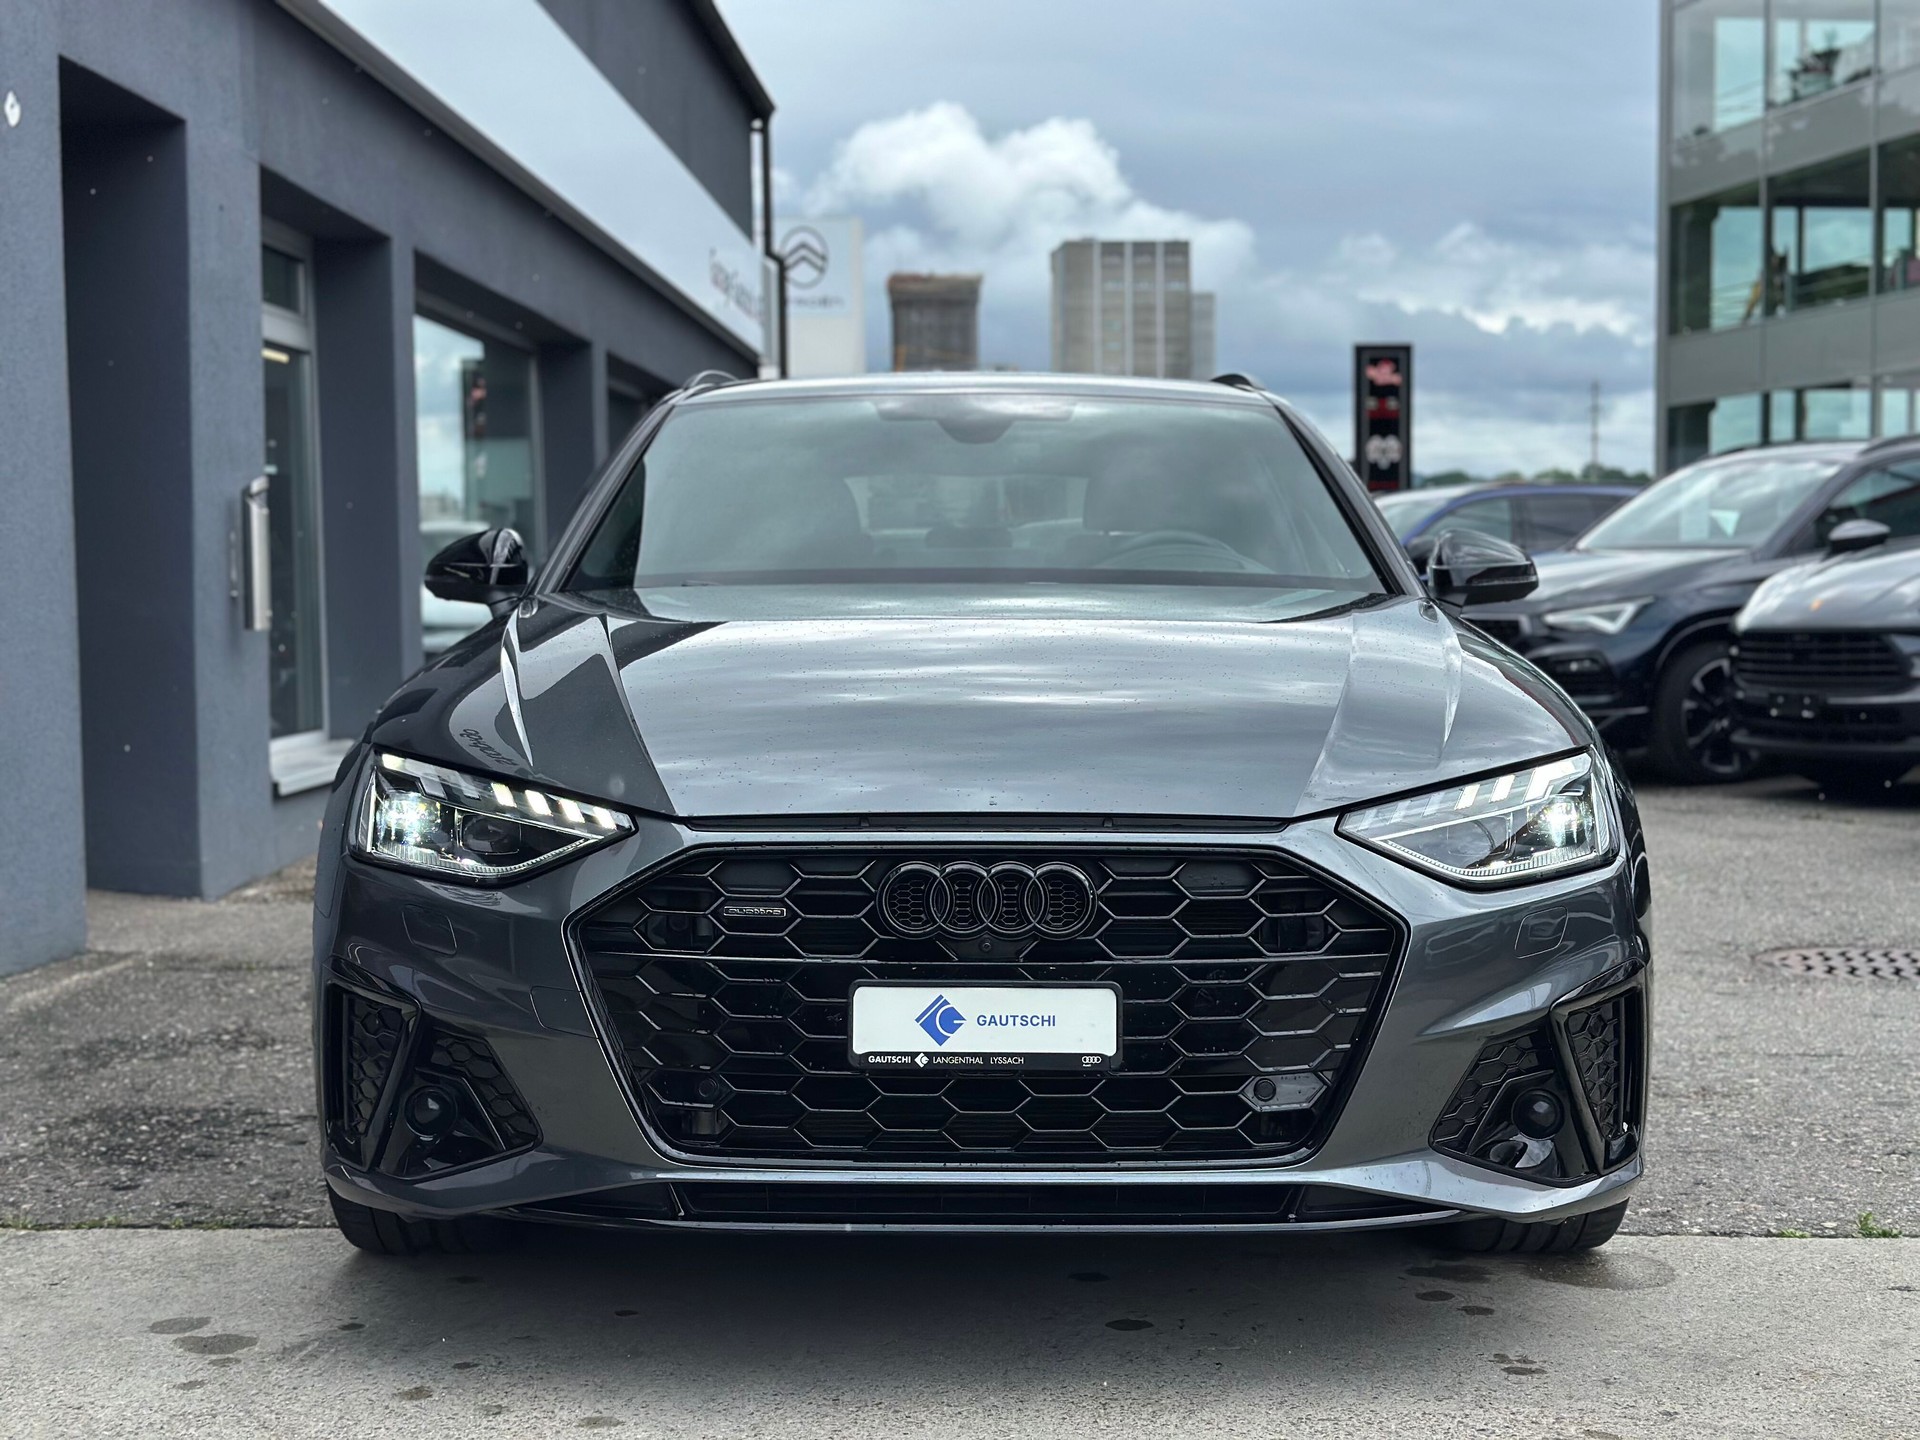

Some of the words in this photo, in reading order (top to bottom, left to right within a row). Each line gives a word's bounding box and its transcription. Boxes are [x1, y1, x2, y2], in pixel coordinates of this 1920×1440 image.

[976, 1014, 1056, 1027] GAUTSCHI
[868, 1055, 911, 1064] GAUTSCHI
[933, 1056, 983, 1065] LANGENTHAL
[990, 1056, 1024, 1065] LYSSACH
